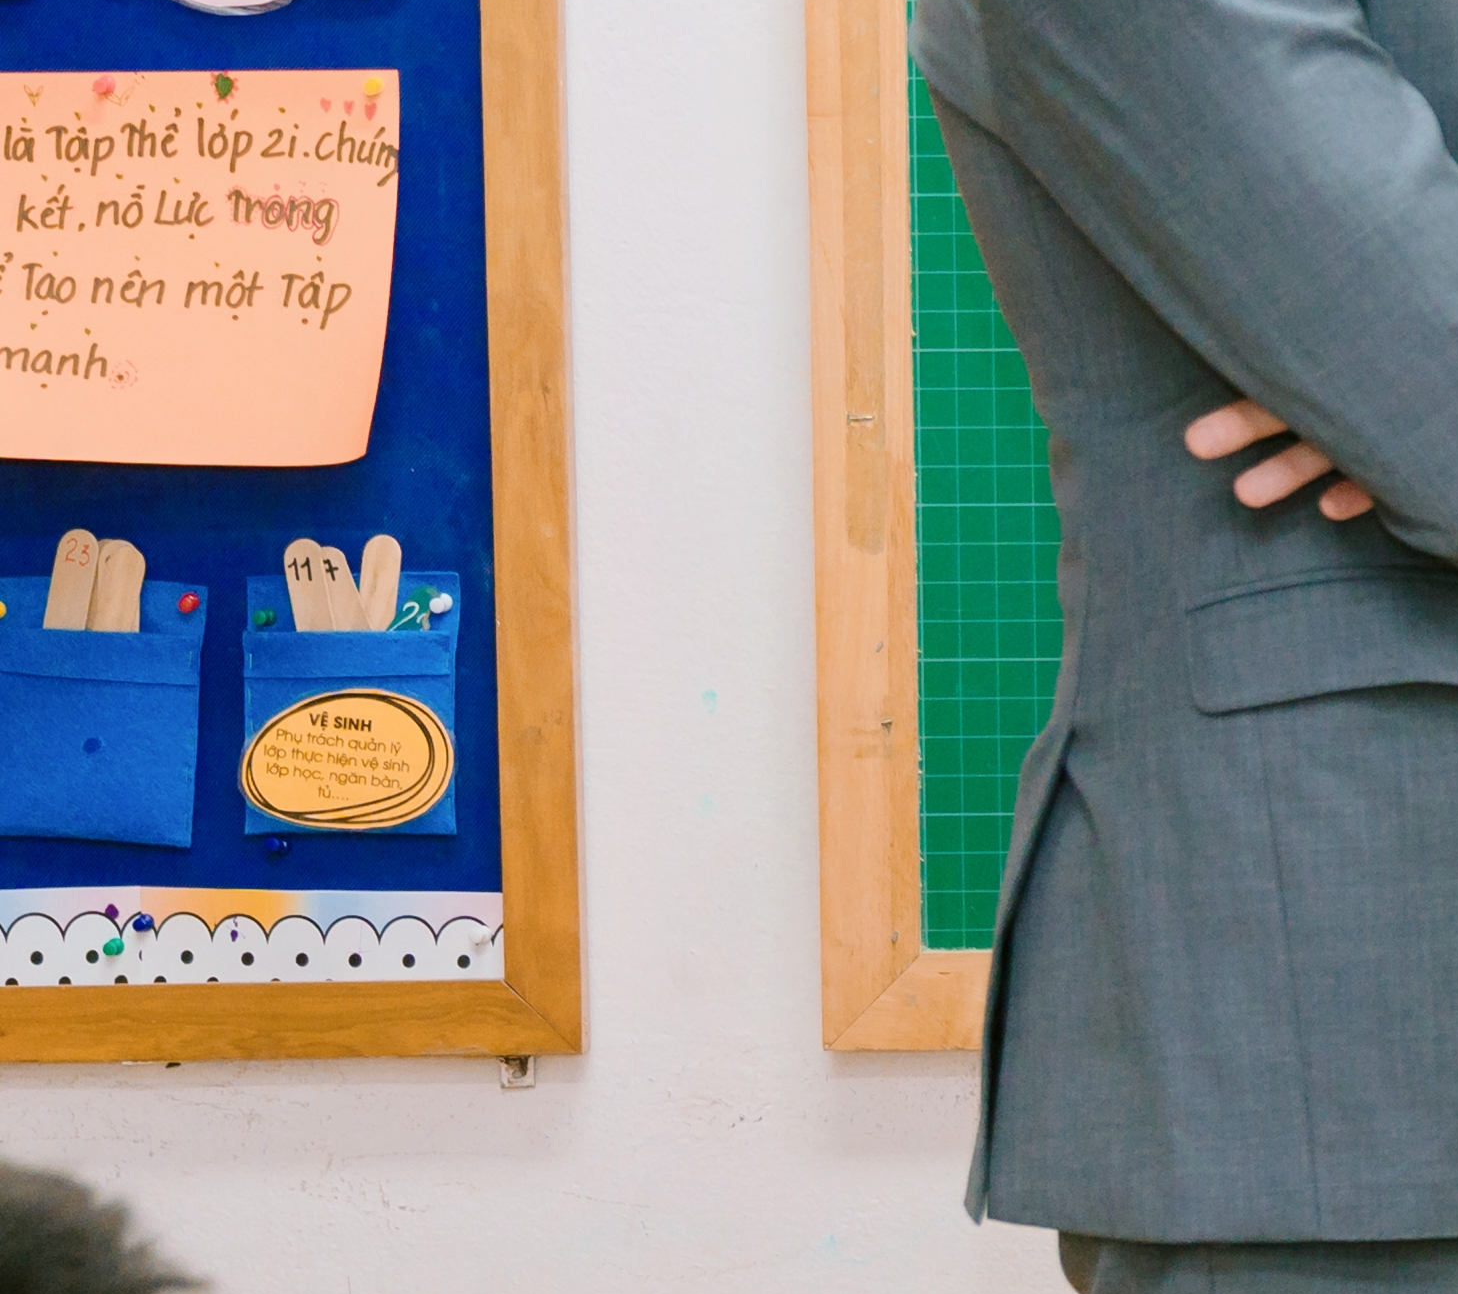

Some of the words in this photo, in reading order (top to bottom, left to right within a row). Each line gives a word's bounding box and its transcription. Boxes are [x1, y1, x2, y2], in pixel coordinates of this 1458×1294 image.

[90, 269, 166, 307] nên
[183, 270, 264, 321] một
[65, 537, 91, 567] 23
[287, 557, 313, 582] 11
[309, 711, 329, 731] VỆ
[333, 716, 373, 733] SINH
[276, 728, 303, 745] Phụ
[306, 732, 345, 748] trách
[348, 737, 387, 753] quản
[390, 741, 402, 757] lý
[291, 747, 324, 764] thực
[326, 752, 358, 768] hiện
[361, 756, 379, 772] vệ
[382, 759, 410, 774] sinh
[329, 771, 367, 787] ngăn
